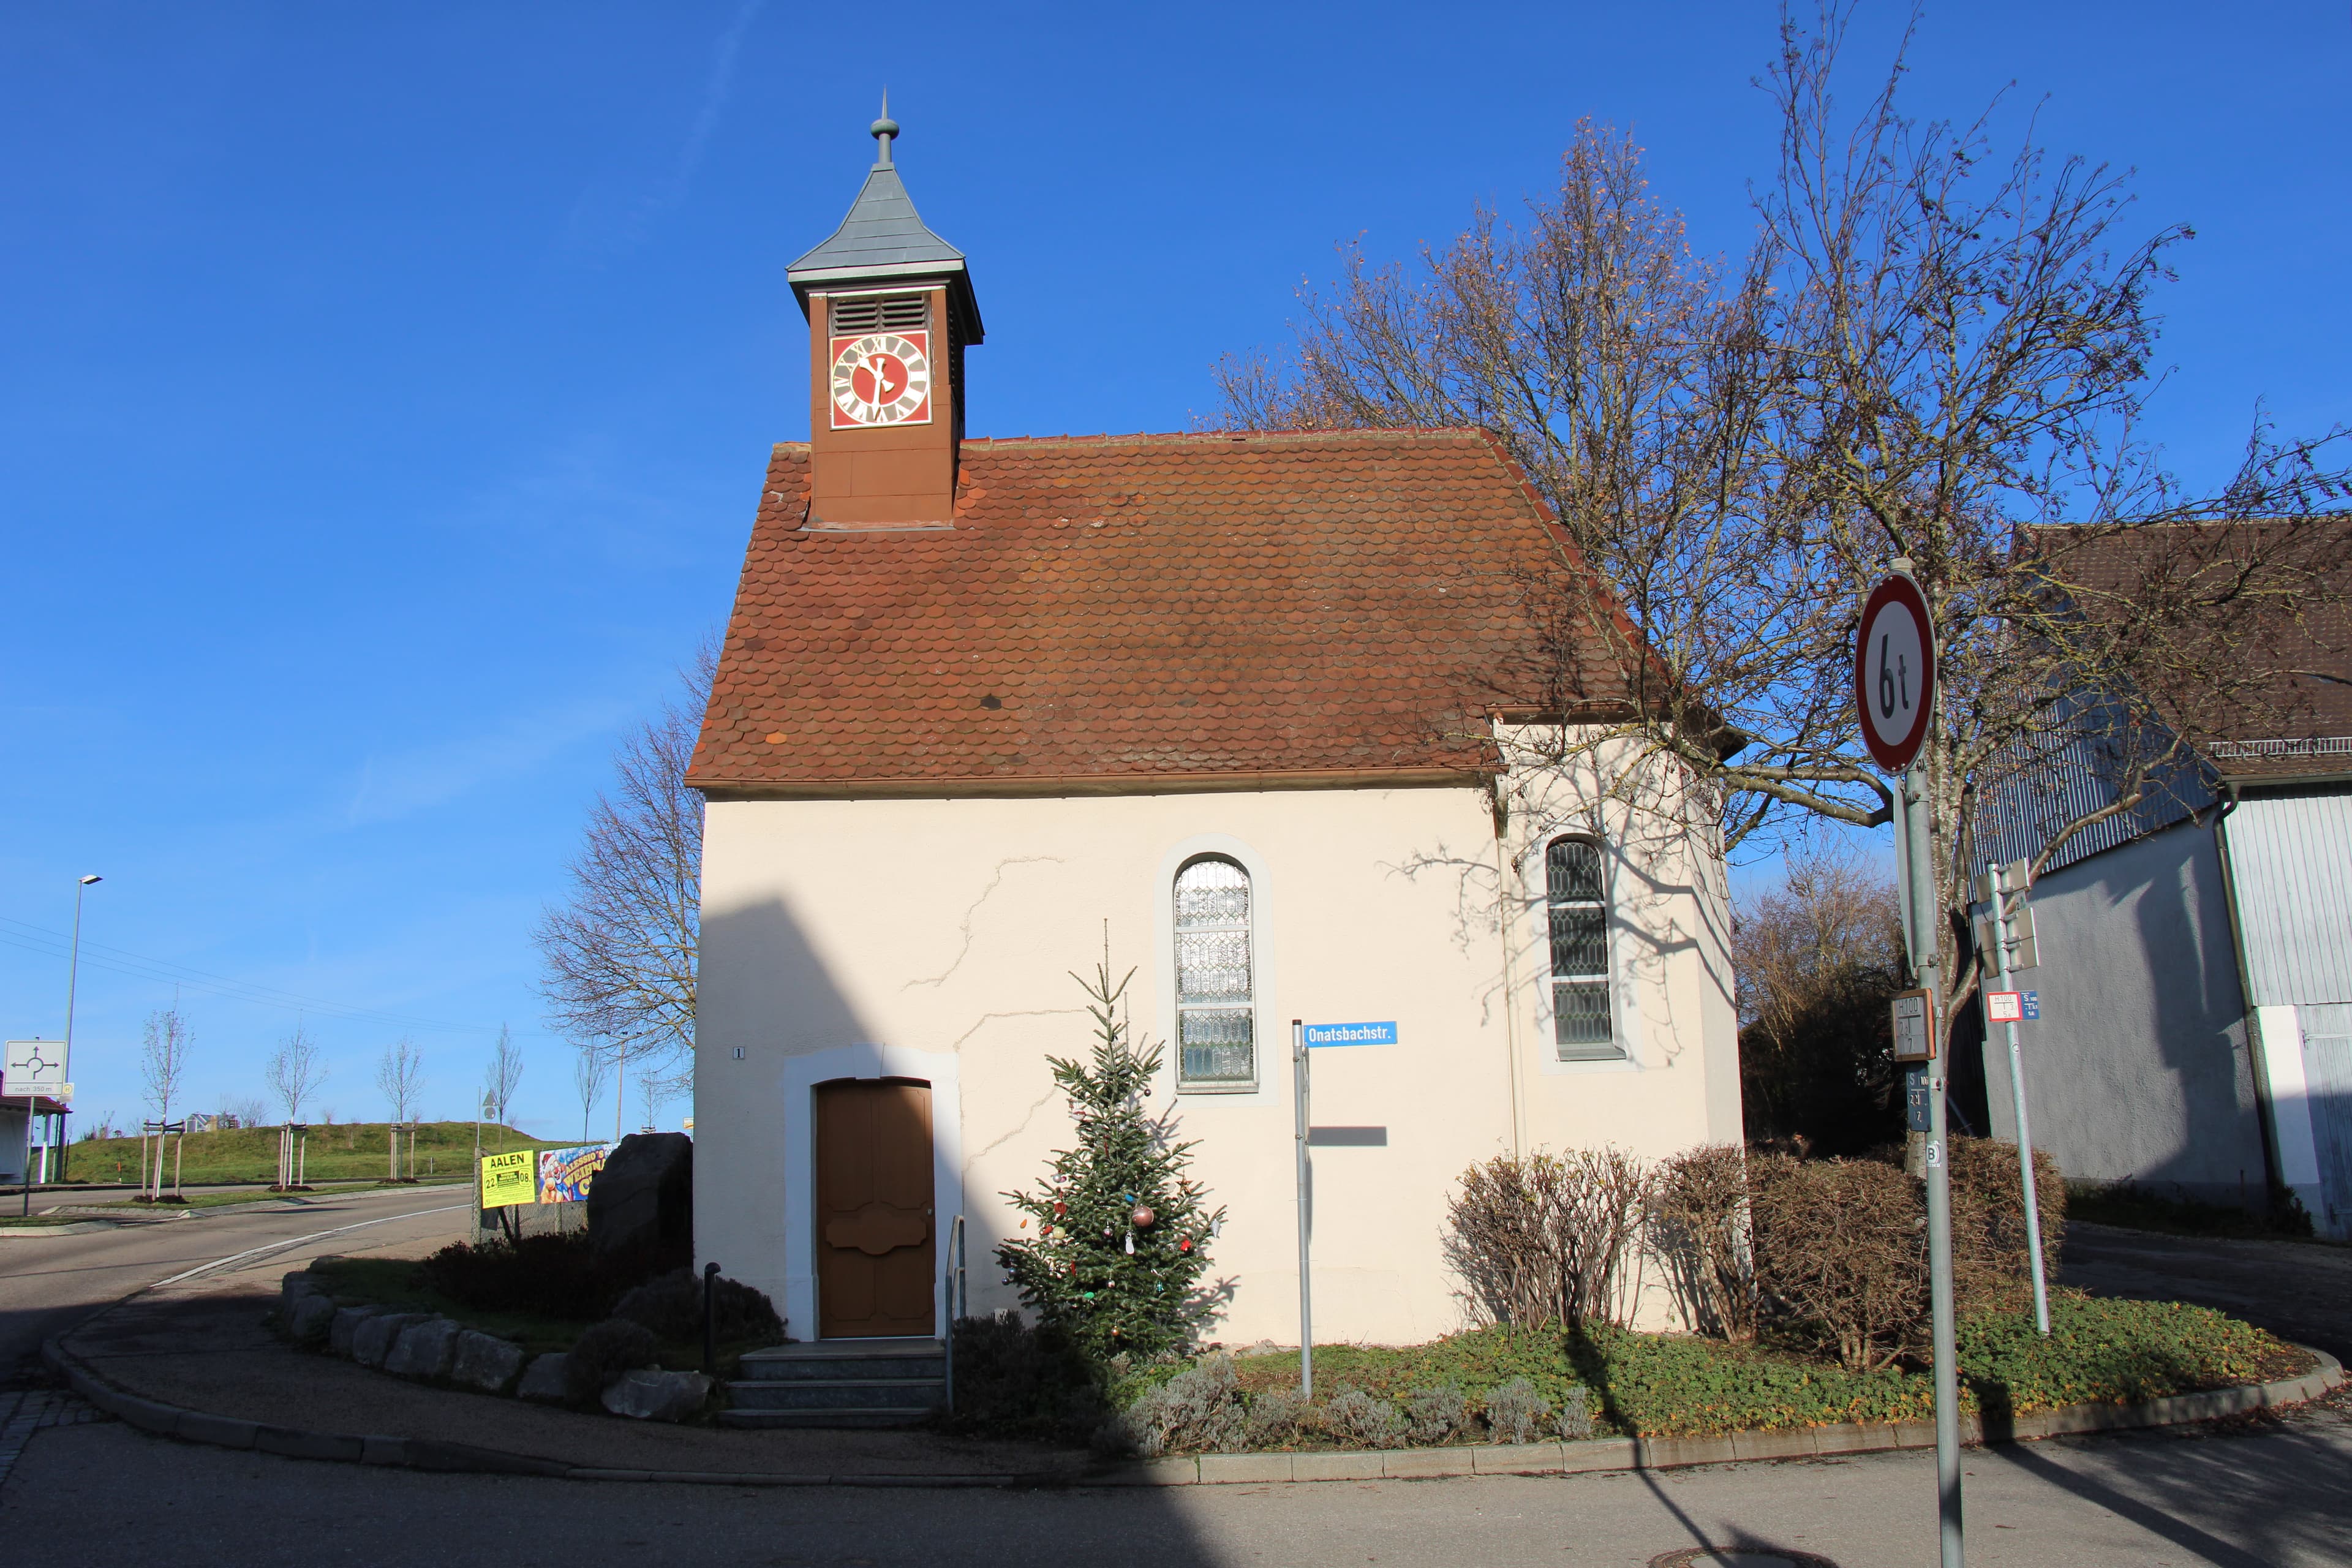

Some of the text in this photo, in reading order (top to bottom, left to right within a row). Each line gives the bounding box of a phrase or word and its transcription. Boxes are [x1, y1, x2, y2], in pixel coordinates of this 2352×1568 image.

[1309, 1025, 1391, 1042] Onatsbachstr.
[737, 1048, 741, 1058] 1
[491, 1153, 525, 1169] AALEN
